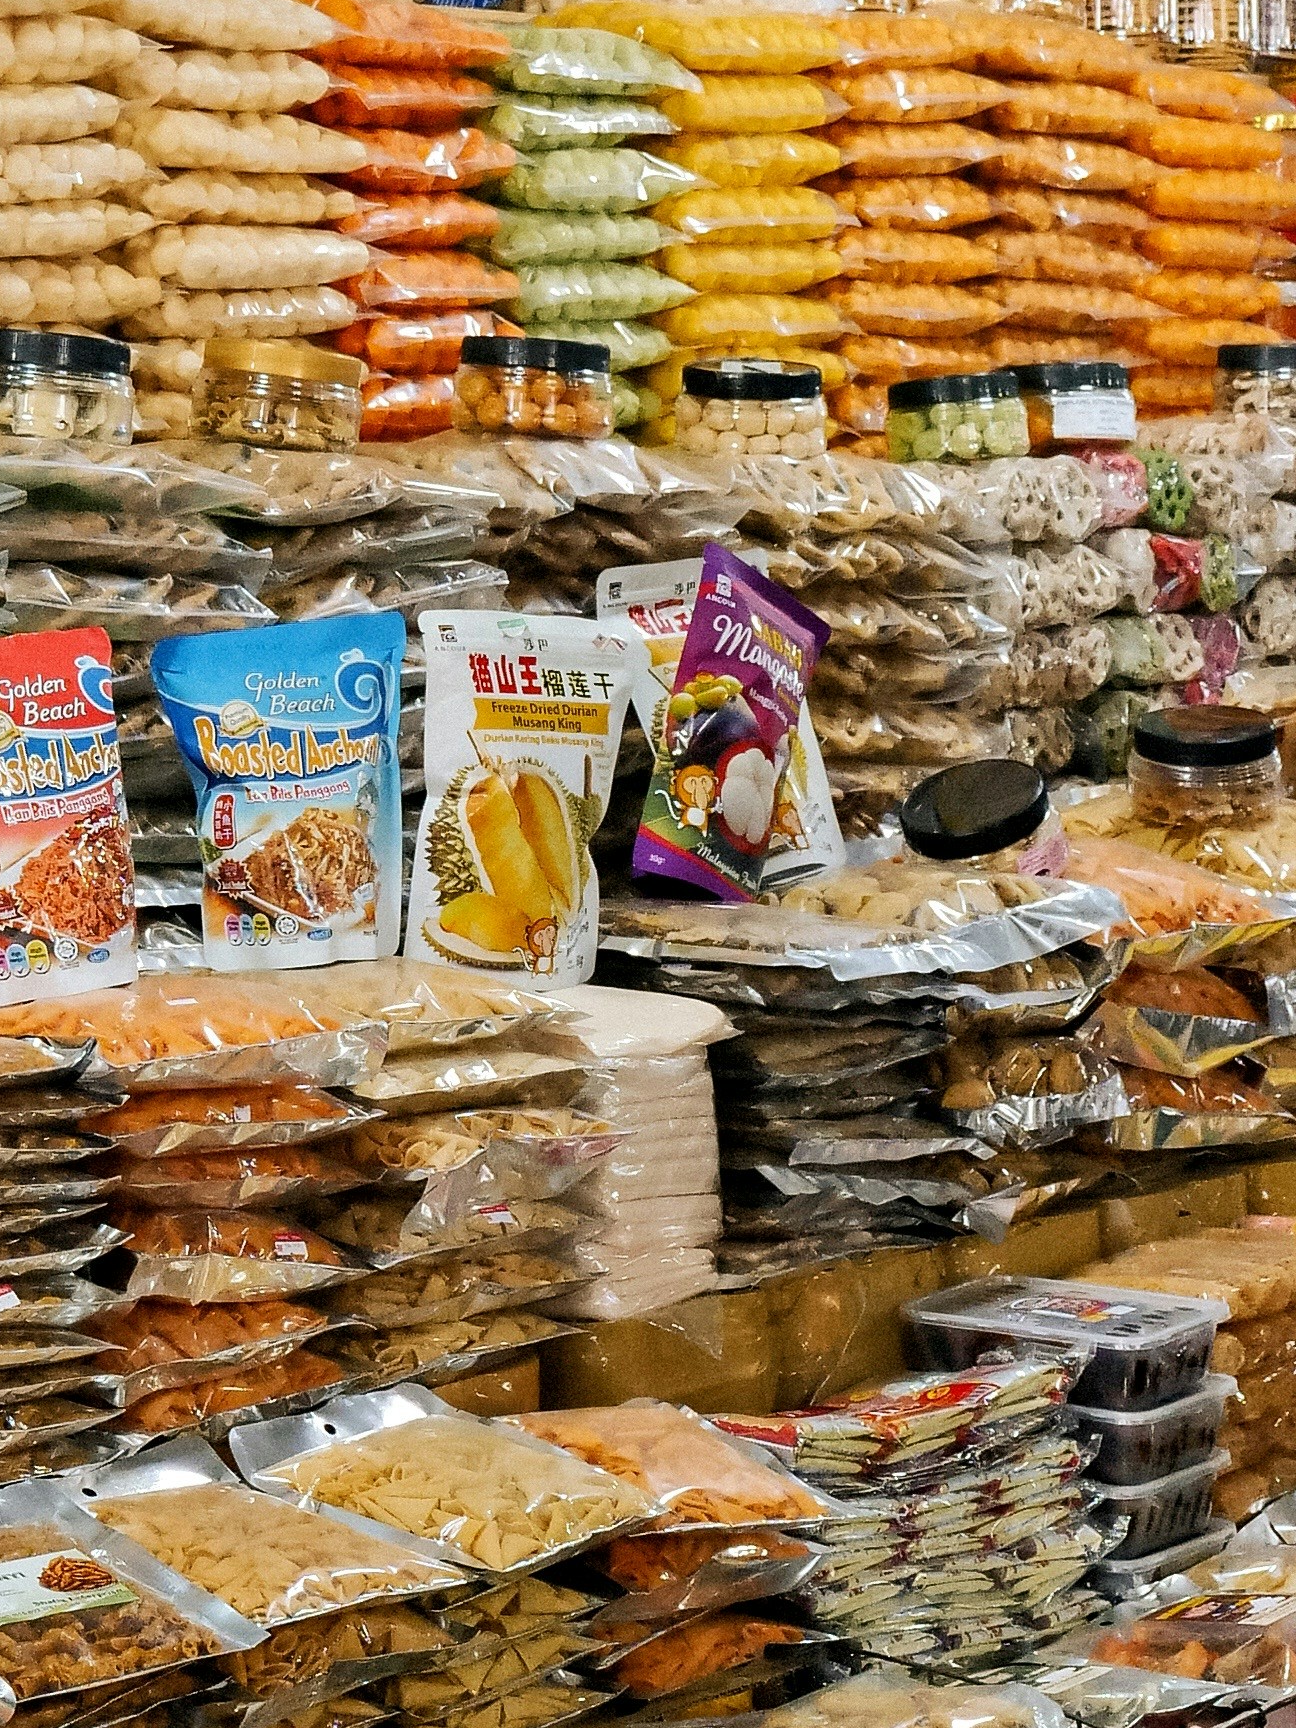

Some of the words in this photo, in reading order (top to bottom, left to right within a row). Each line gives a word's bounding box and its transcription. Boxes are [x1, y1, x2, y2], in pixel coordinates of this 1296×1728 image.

[244, 671, 320, 703] Golden
[24, 697, 86, 726] Beach
[269, 693, 336, 716] Beach
[491, 702, 528, 713] Freeze
[530, 703, 560, 714] Dried
[563, 704, 598, 717] Durian
[512, 716, 555, 731] Musang
[558, 718, 582, 732] King
[194, 716, 303, 780] Roasted
[294, 781, 351, 800] Panggang
[56, 790, 112, 816] Panggang
